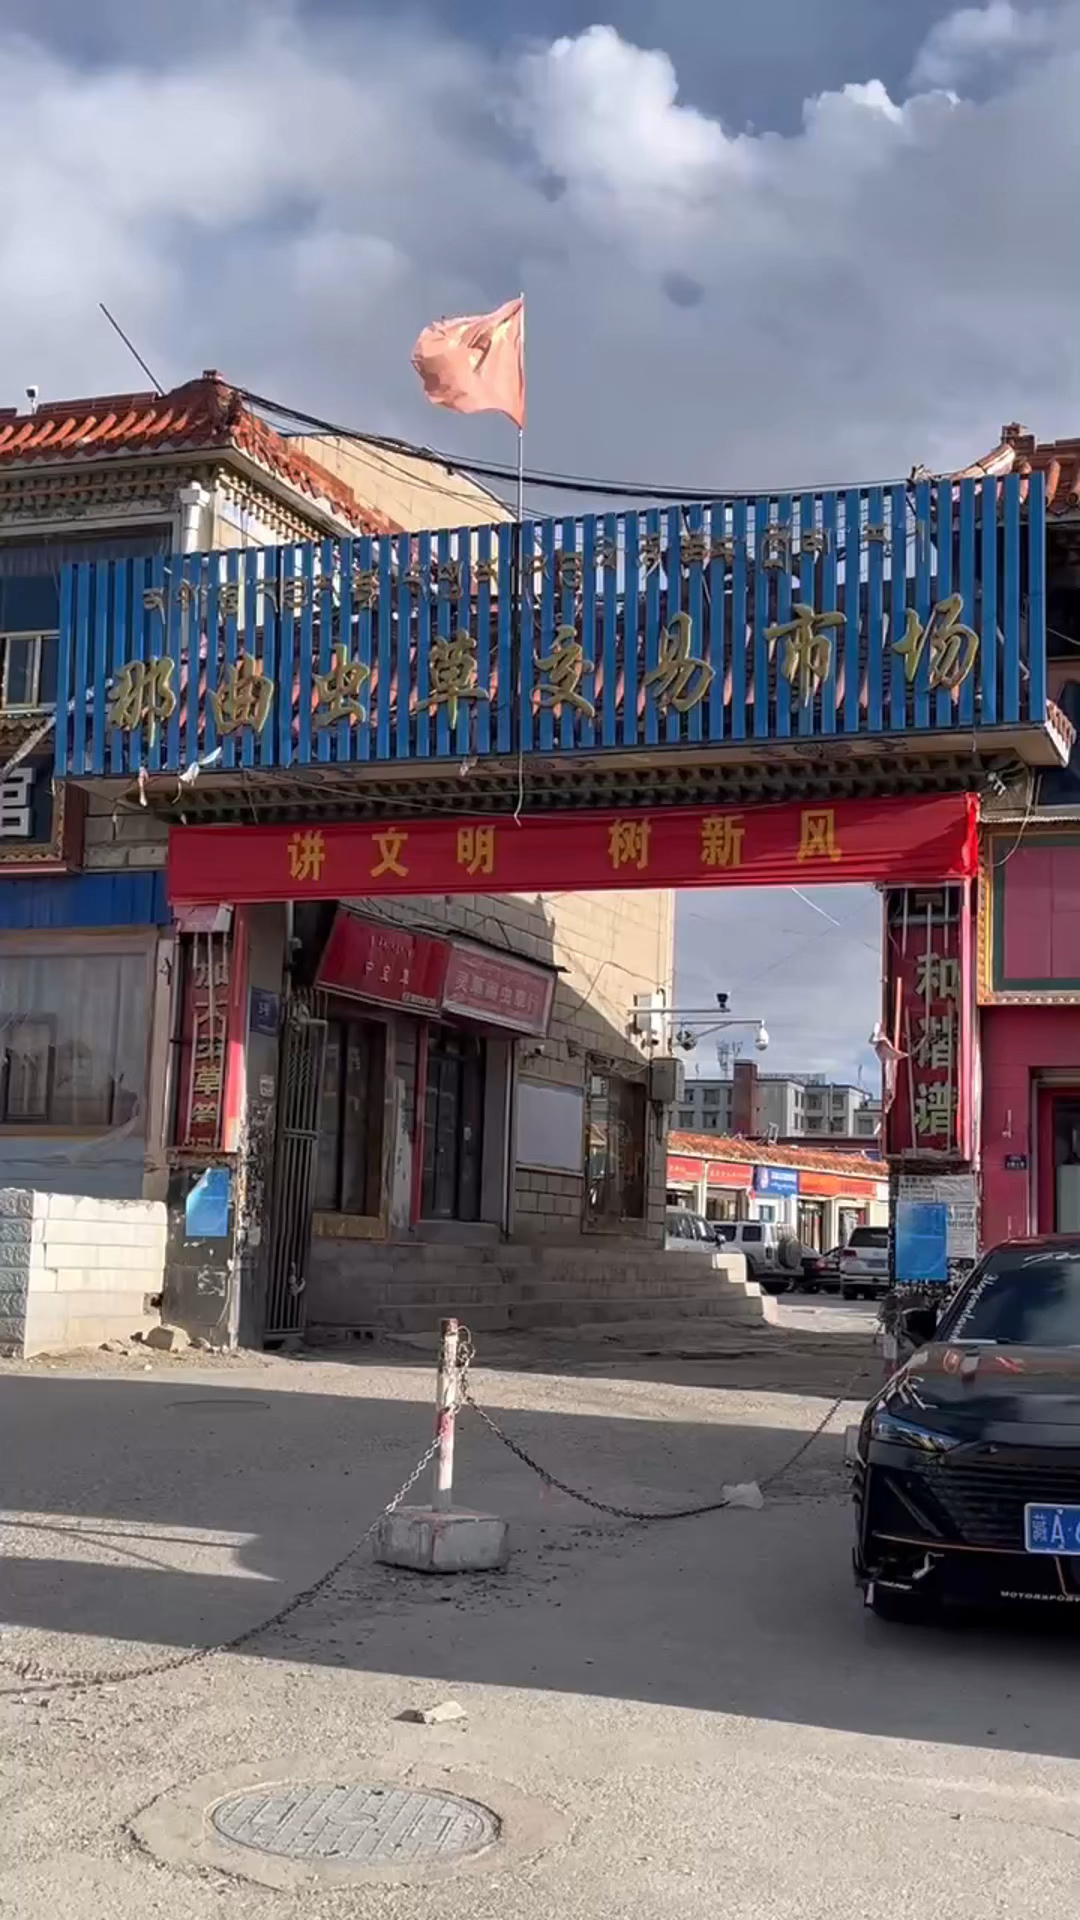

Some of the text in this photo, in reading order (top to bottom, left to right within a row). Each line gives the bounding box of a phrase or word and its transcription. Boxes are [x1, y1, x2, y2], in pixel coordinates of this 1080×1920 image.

[107, 592, 980, 748] 那曲虫草交易市场
[287, 808, 843, 882] 讲文明 树新风
